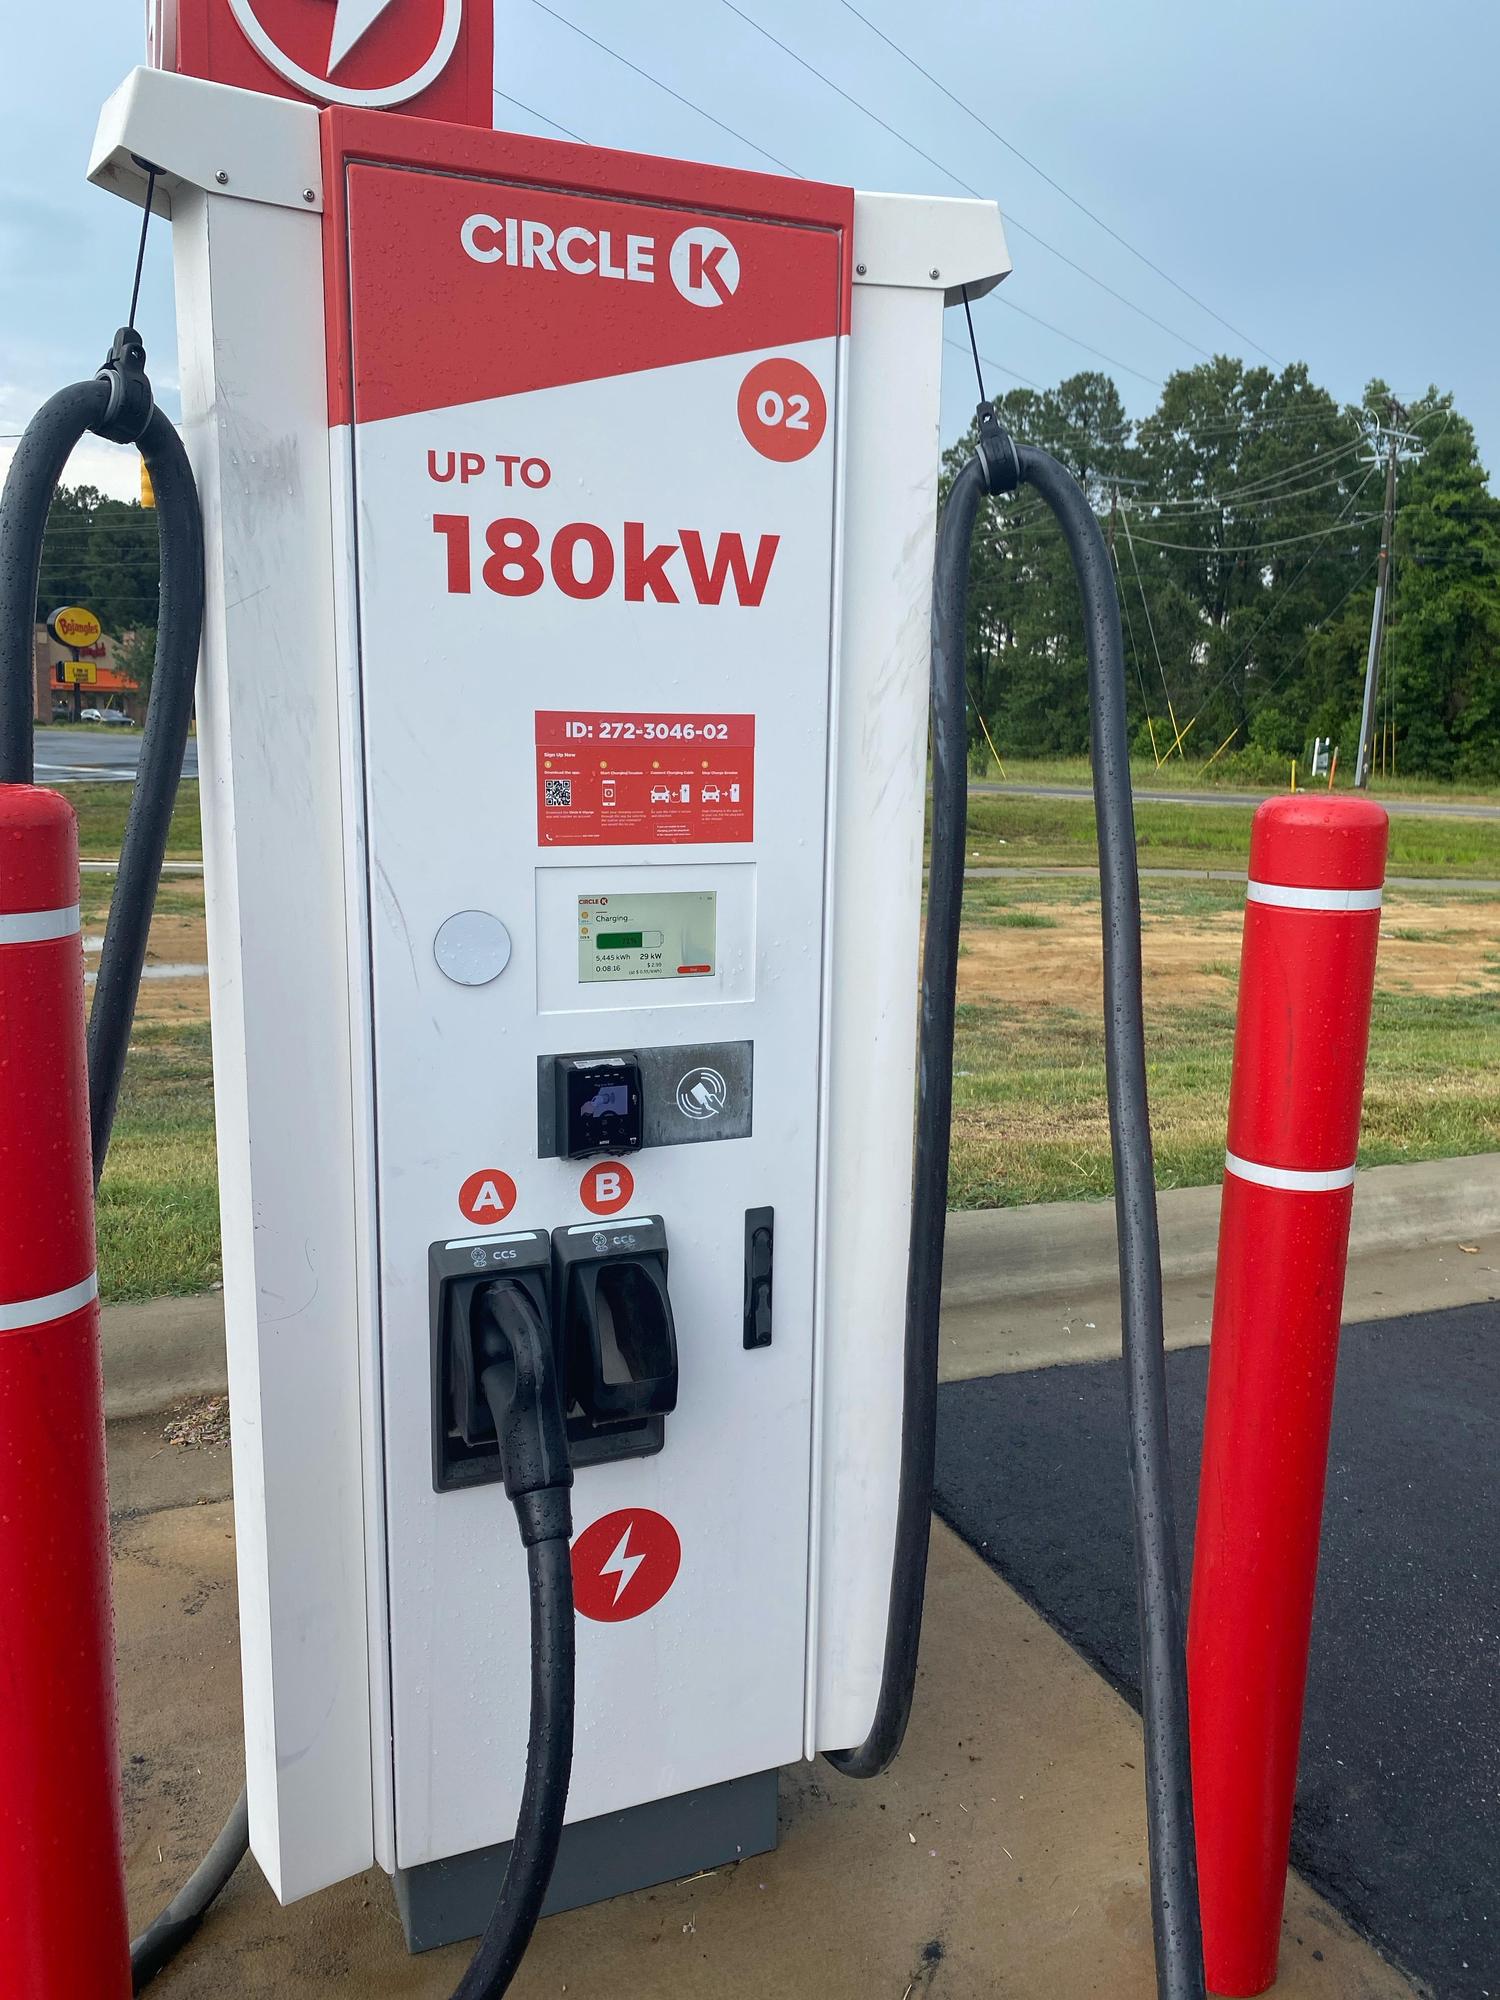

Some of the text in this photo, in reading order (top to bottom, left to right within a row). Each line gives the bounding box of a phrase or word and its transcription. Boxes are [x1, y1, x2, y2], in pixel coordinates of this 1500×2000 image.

[460, 213, 655, 284] CIRCLE
[756, 390, 810, 430] 02
[427, 449, 551, 489] UP TO
[432, 513, 781, 608] 180kW
[565, 721, 729, 740] ID: 272-3046-02
[472, 1181, 504, 1212] A
[595, 1172, 622, 1202] B
[493, 1249, 517, 1260] CCS
